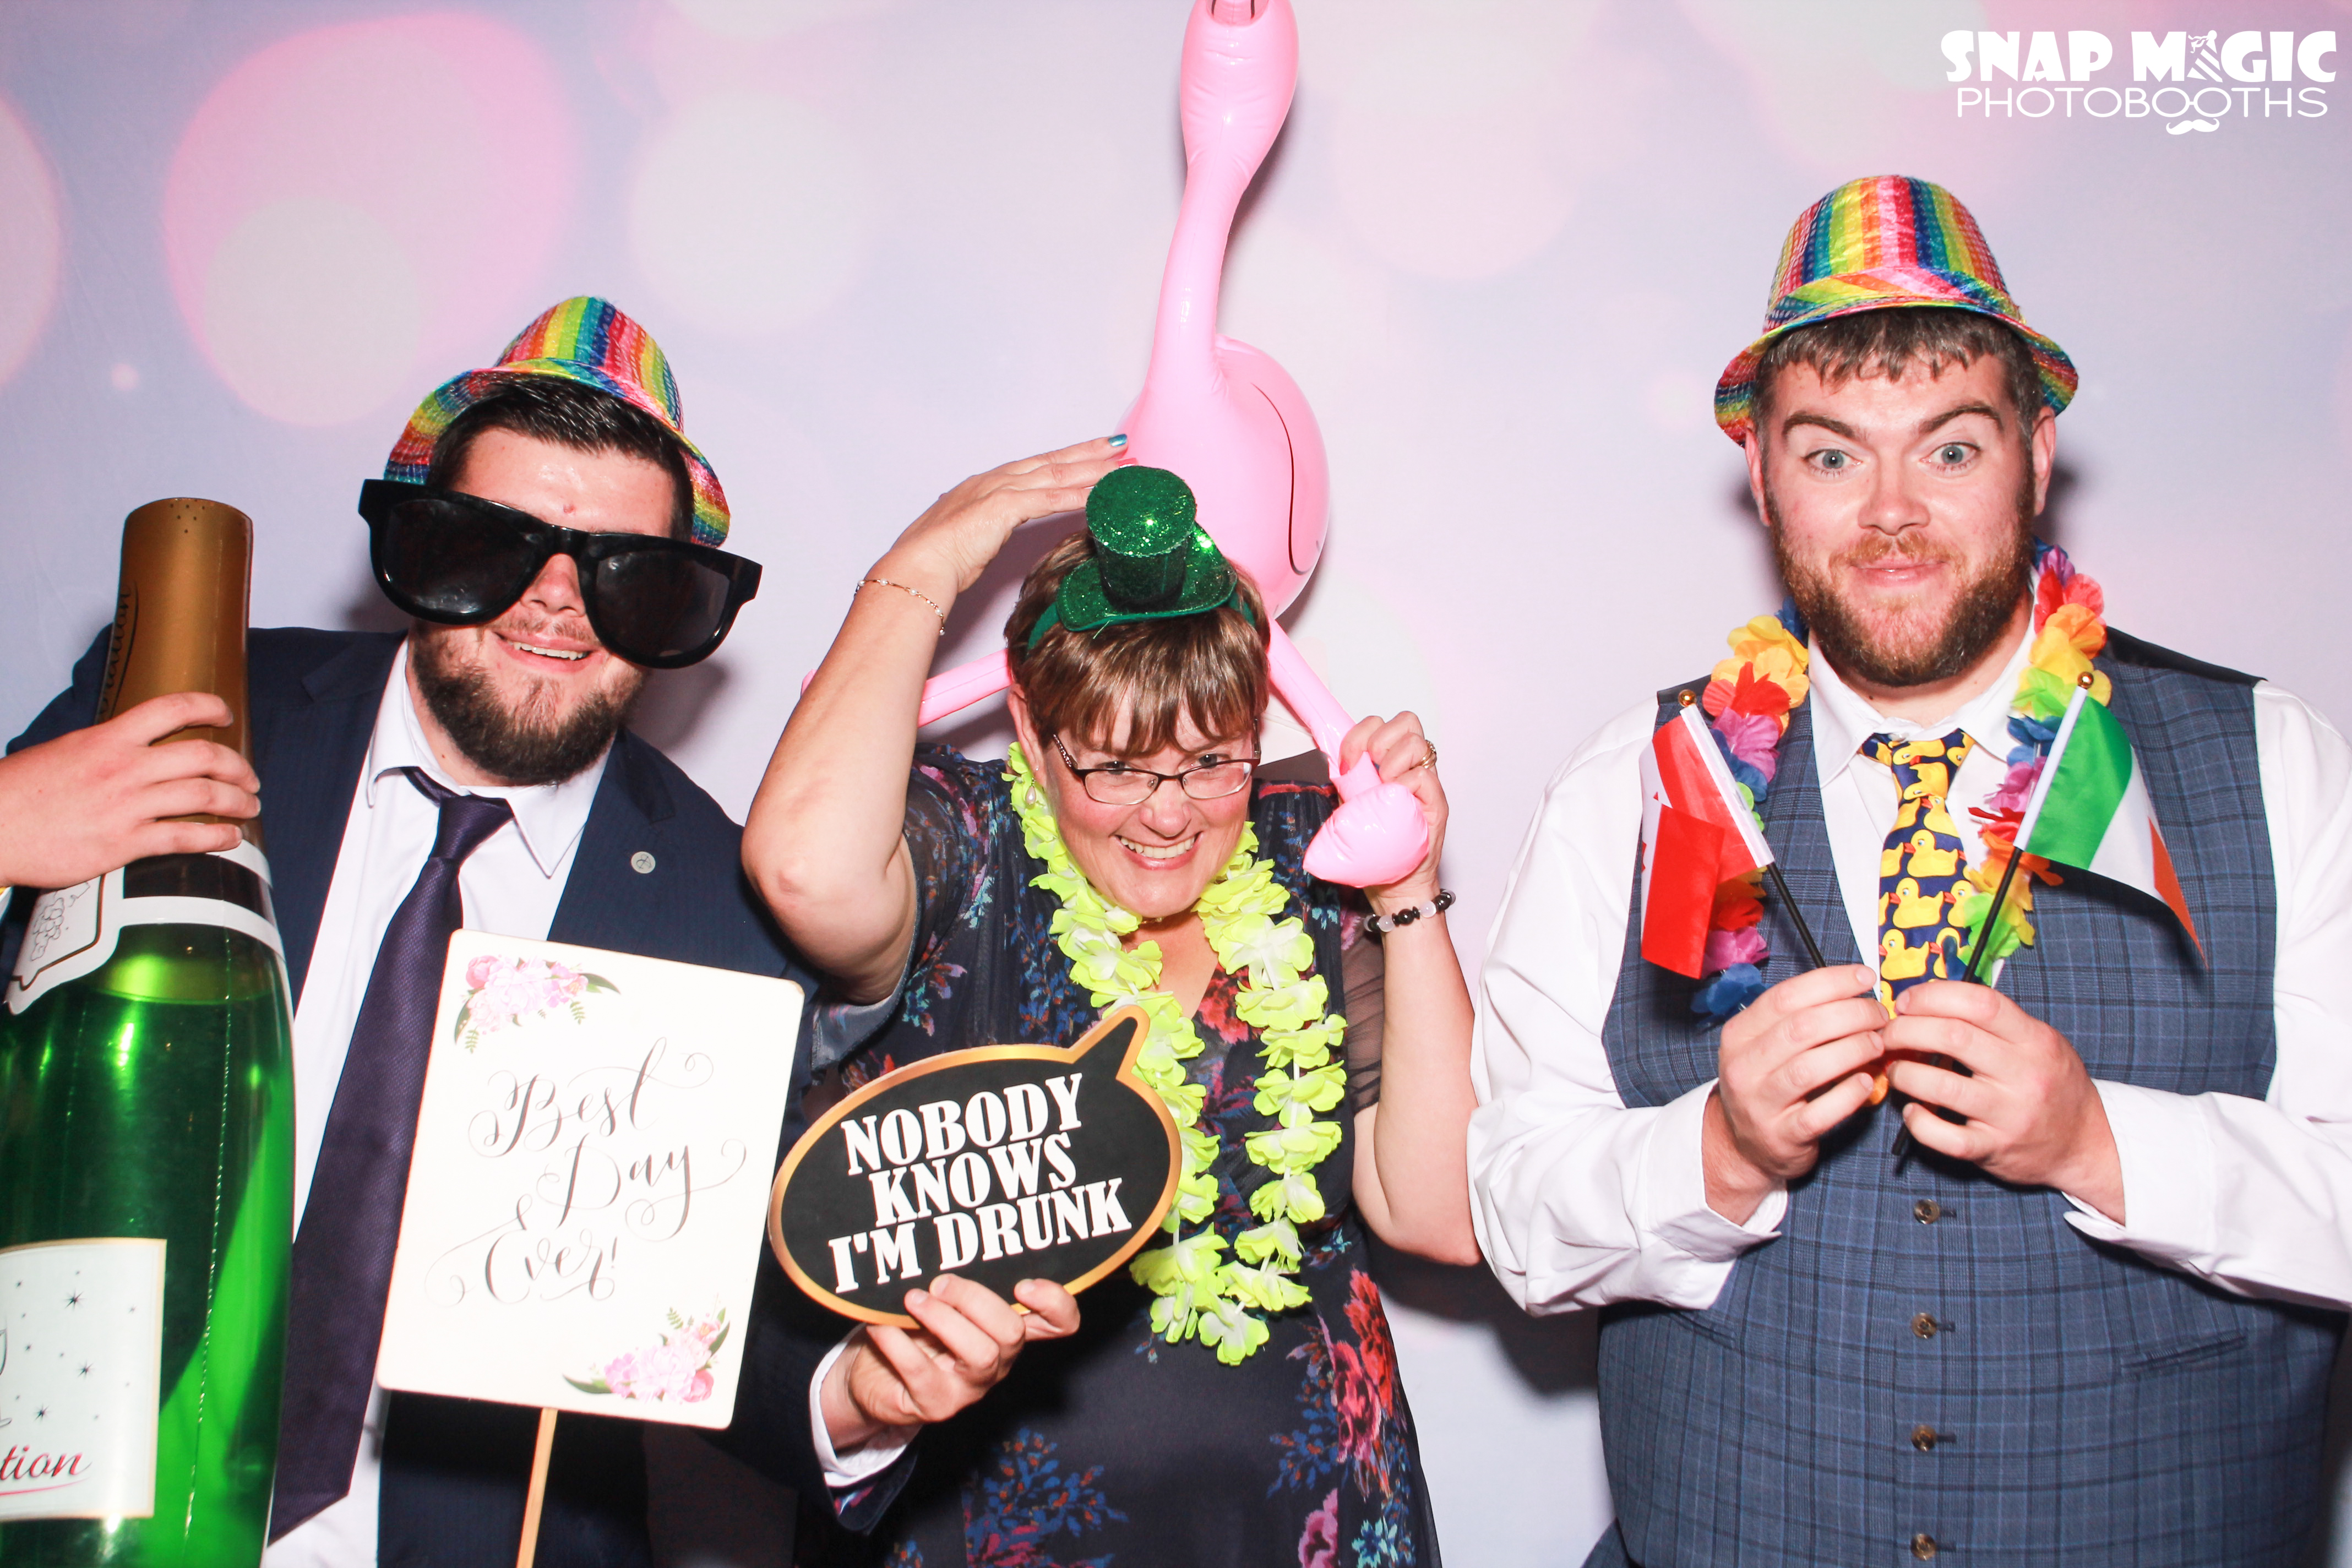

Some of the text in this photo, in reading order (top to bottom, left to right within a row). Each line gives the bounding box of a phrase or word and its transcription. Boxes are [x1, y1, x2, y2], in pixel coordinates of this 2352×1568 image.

[469, 1037, 714, 1157] Best
[841, 1073, 1082, 1175] NOBODY
[536, 1133, 747, 1242] Day
[829, 1177, 1132, 1293] I'M DRUNK
[868, 1132, 1076, 1227] KNOWS
[424, 1194, 617, 1307] Ever!
